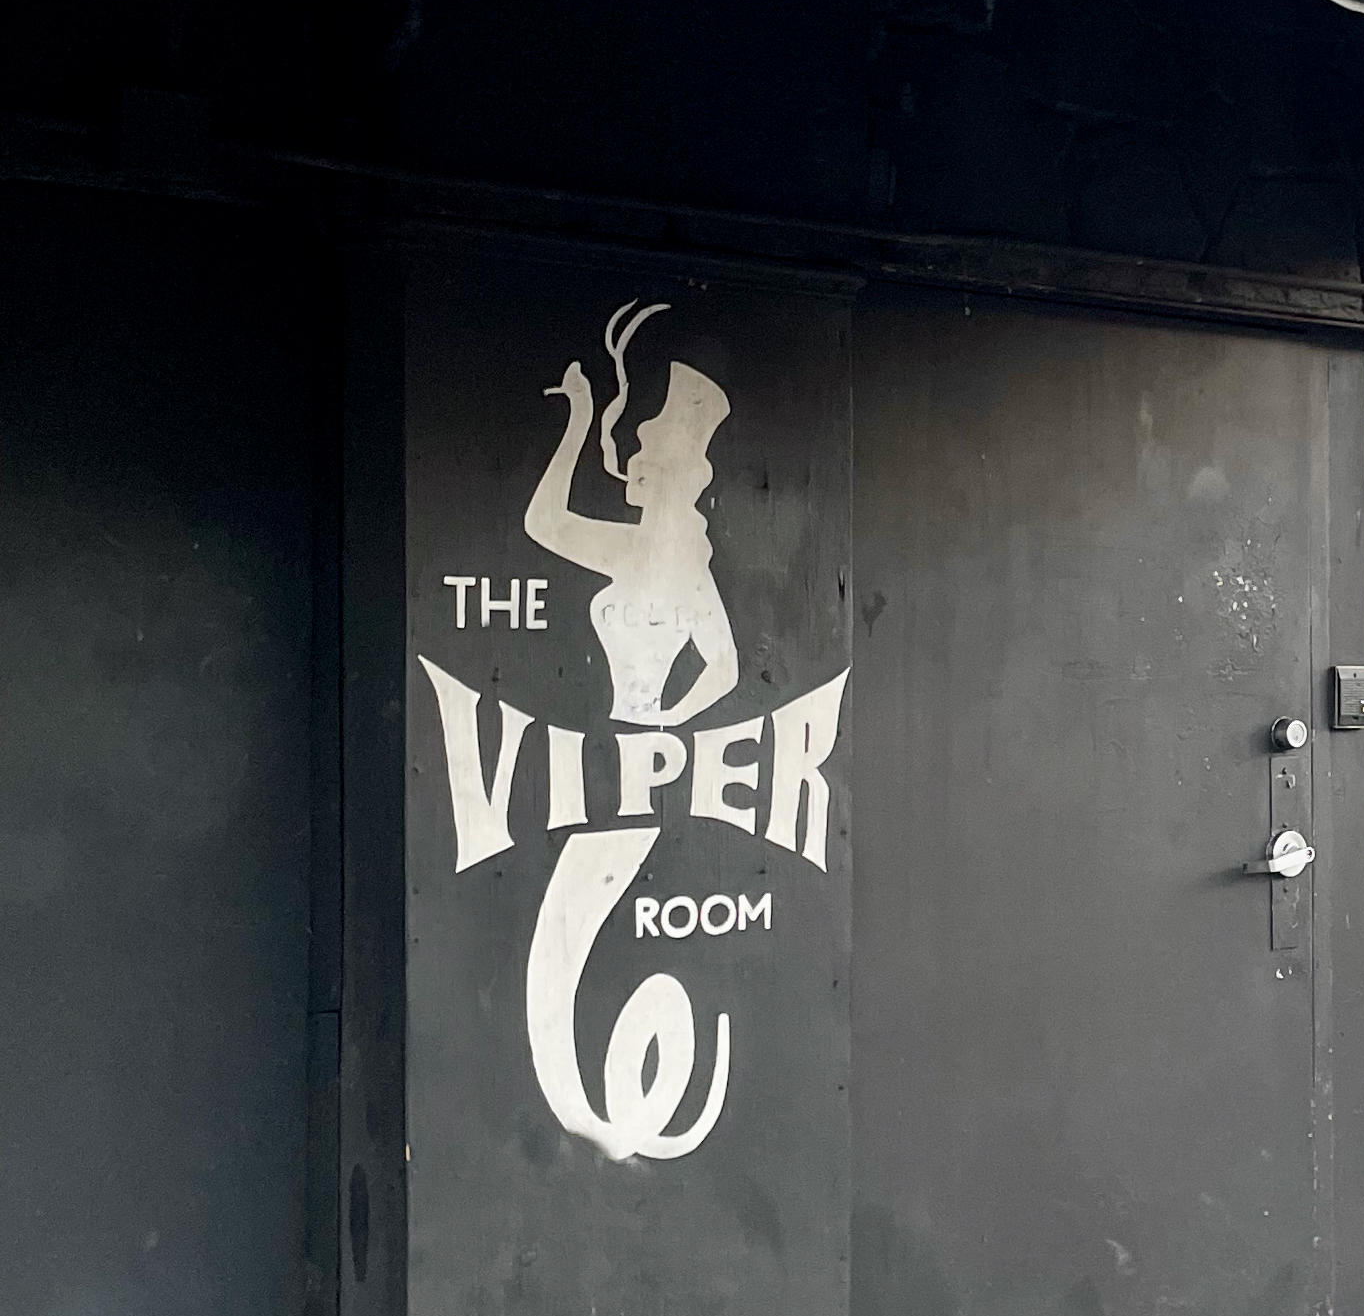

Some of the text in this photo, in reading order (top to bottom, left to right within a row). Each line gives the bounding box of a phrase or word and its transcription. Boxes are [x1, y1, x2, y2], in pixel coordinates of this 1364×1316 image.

[443, 575, 549, 631] THE
[418, 654, 851, 873] VIPER
[635, 893, 772, 939] ROOM
